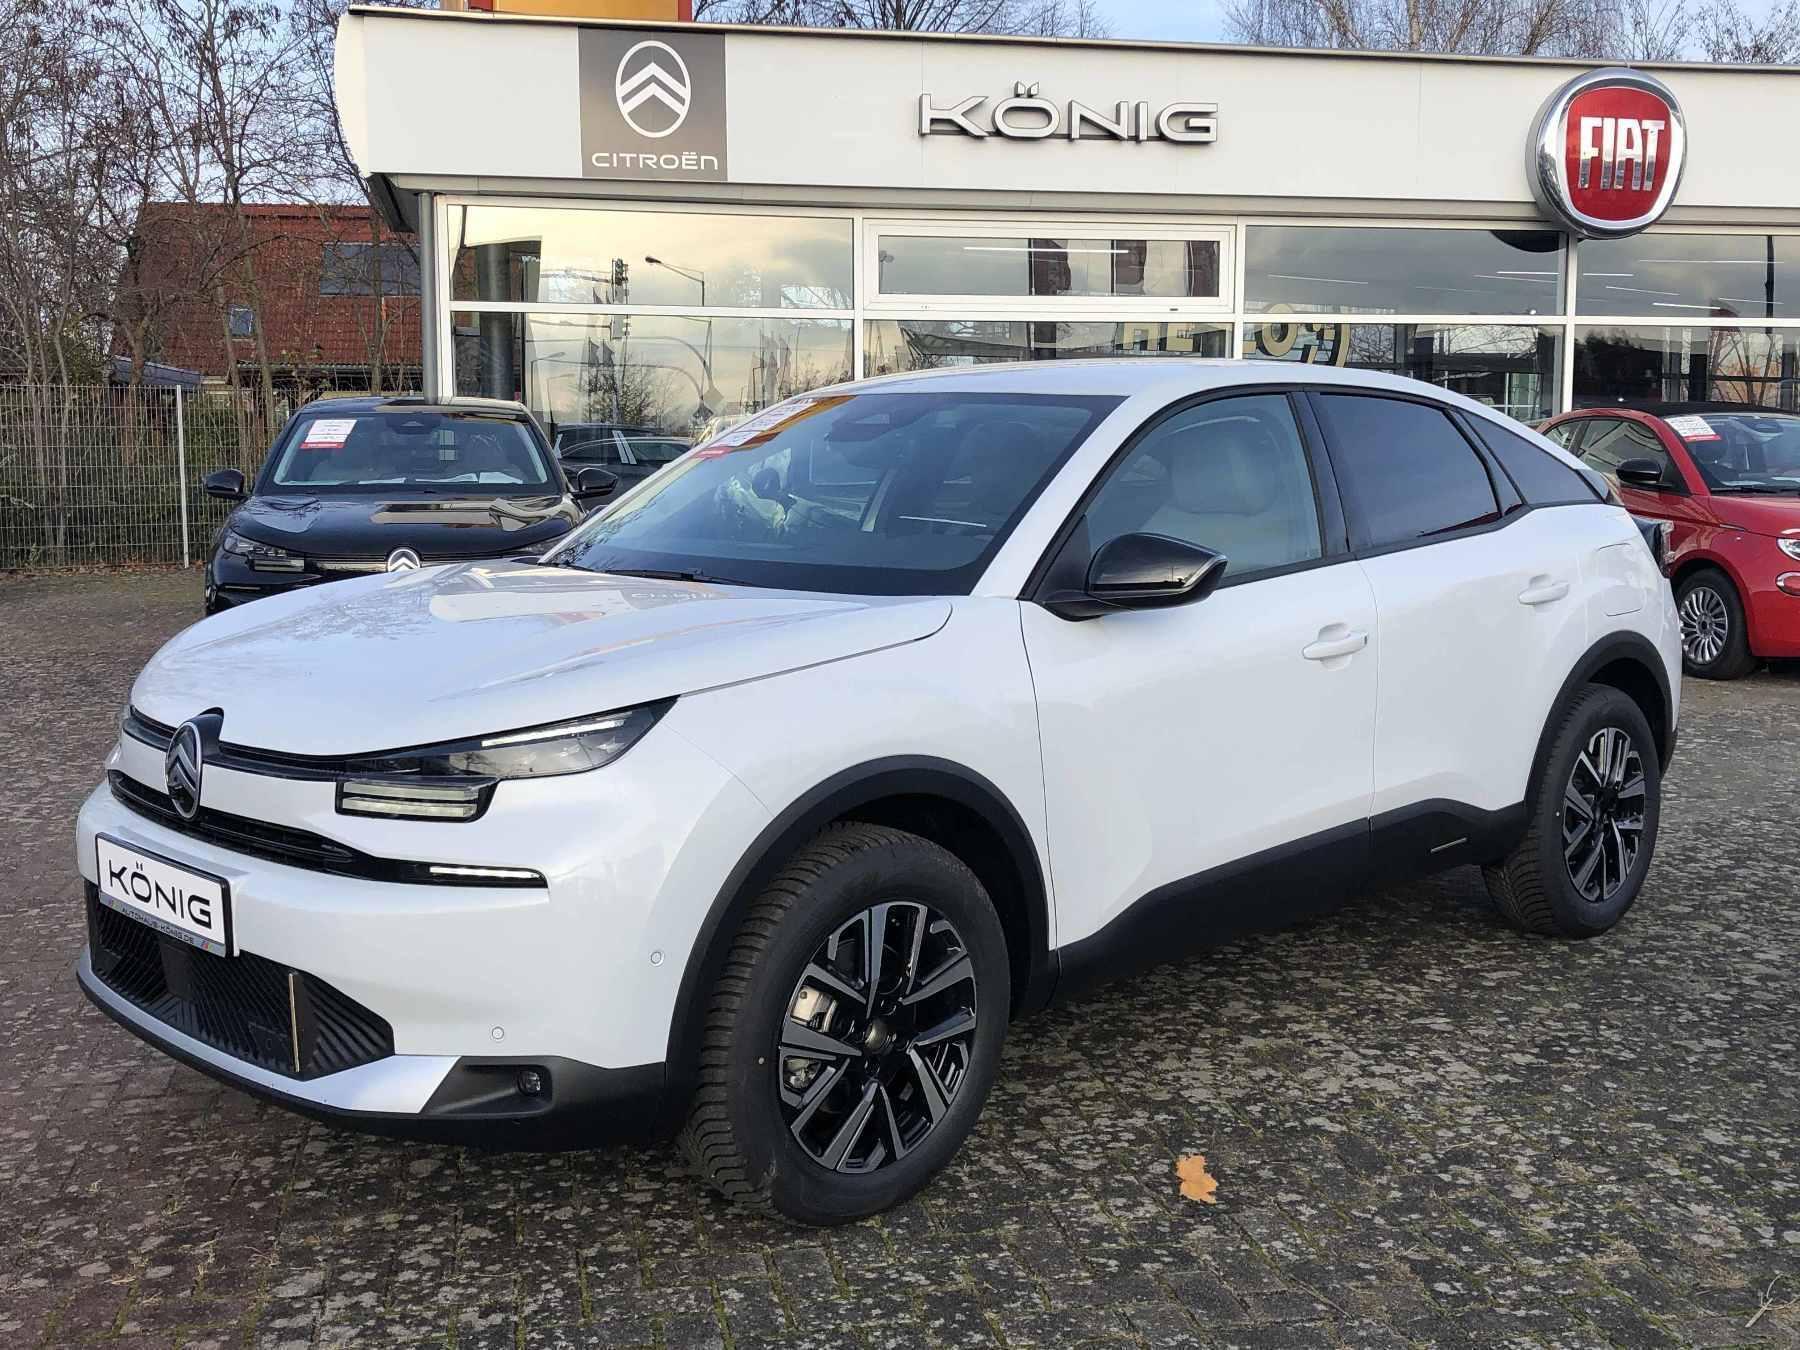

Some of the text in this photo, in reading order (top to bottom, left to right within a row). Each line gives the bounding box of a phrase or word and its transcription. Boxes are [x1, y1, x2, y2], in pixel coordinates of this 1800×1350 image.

[918, 80, 1219, 143] KÖNIG
[591, 151, 719, 171] CITROËN
[1578, 115, 1665, 191] FIAT
[108, 859, 212, 930] KÖNIG
